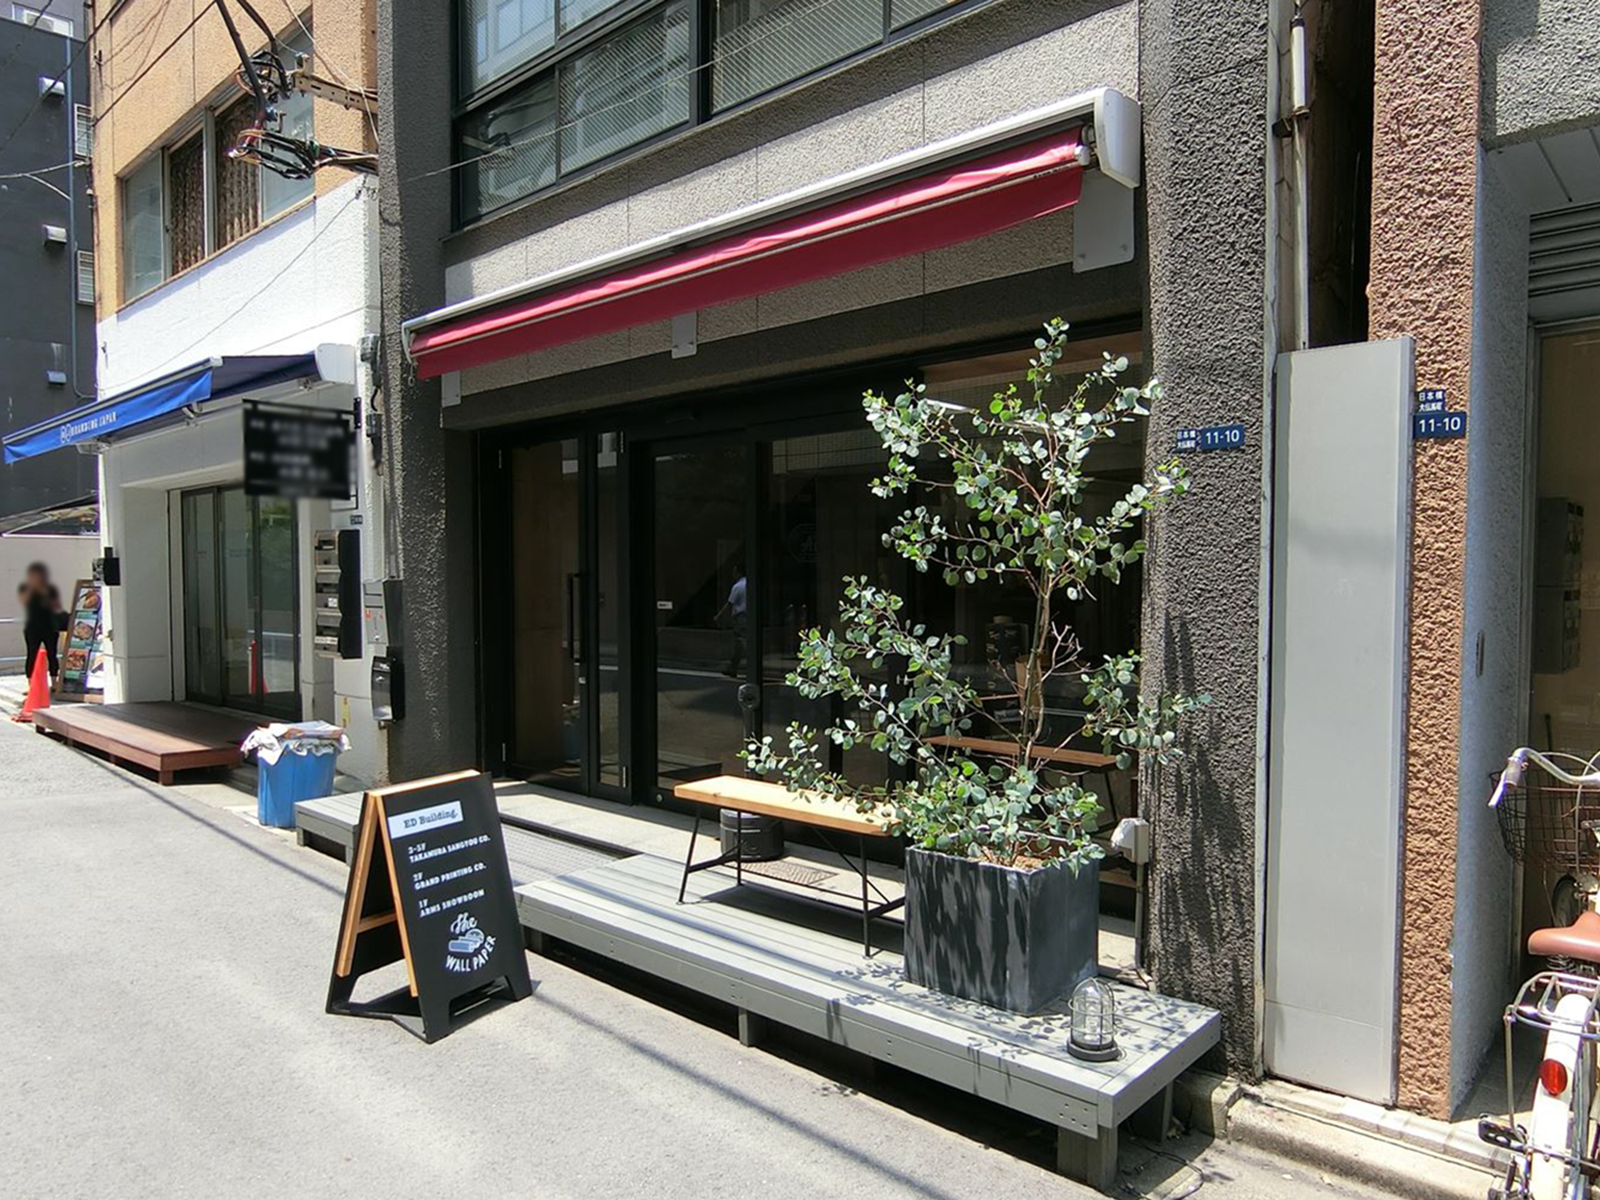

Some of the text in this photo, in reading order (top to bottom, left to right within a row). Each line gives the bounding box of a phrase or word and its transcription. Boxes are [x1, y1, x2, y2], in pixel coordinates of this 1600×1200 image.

[1205, 429, 1240, 444] 11-10
[1419, 417, 1461, 433] 11-10
[403, 818, 417, 828] ED
[409, 847, 447, 863] TAKAMURA
[479, 834, 491, 843] CO.
[414, 862, 487, 891] GRAND PRINTING CO.
[420, 889, 485, 918] ARMS SHOWROOM
[445, 935, 497, 973] WALL PAPER
